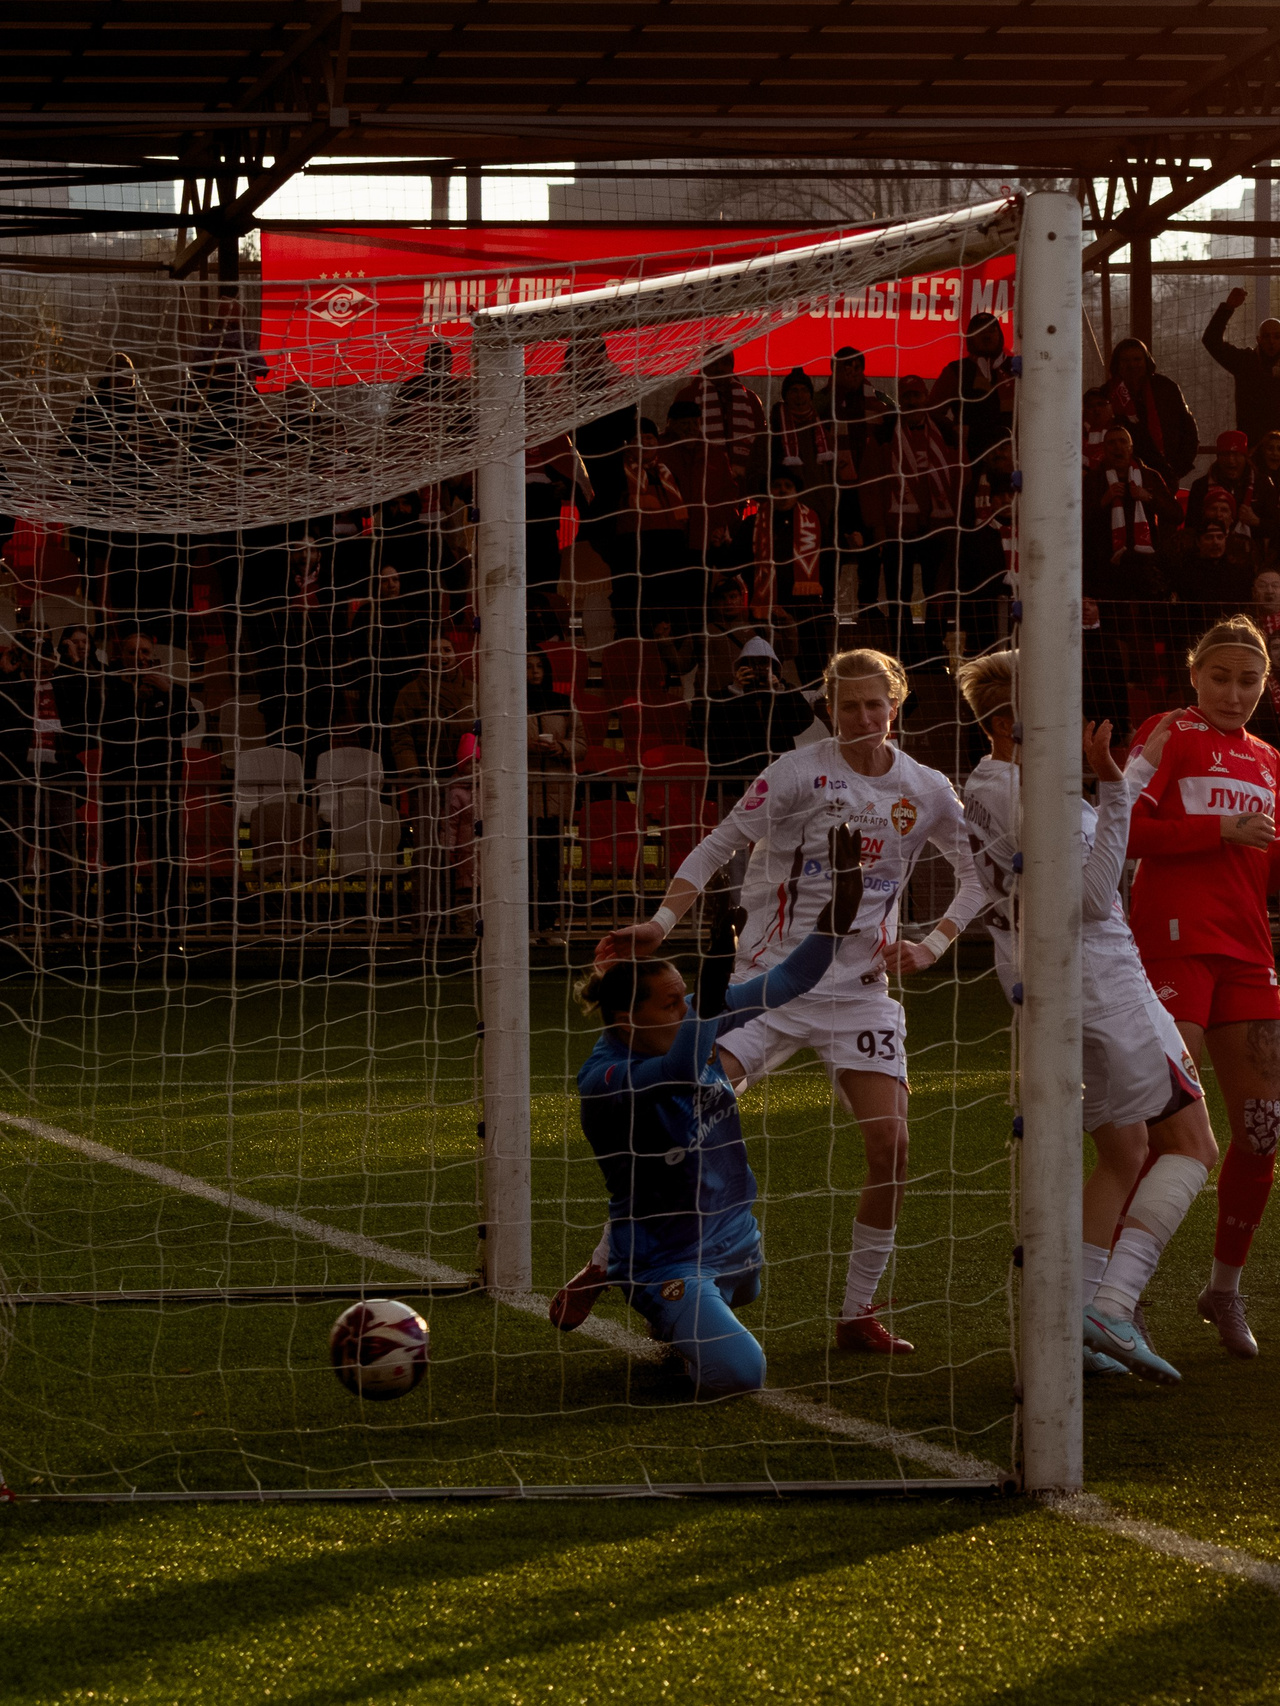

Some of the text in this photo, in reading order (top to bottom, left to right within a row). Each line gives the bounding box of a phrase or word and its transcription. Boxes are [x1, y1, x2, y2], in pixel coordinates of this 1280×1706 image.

[910, 277, 961, 321] БЕЗ
[970, 279, 1015, 323] МА
[856, 1030, 896, 1060] 93
